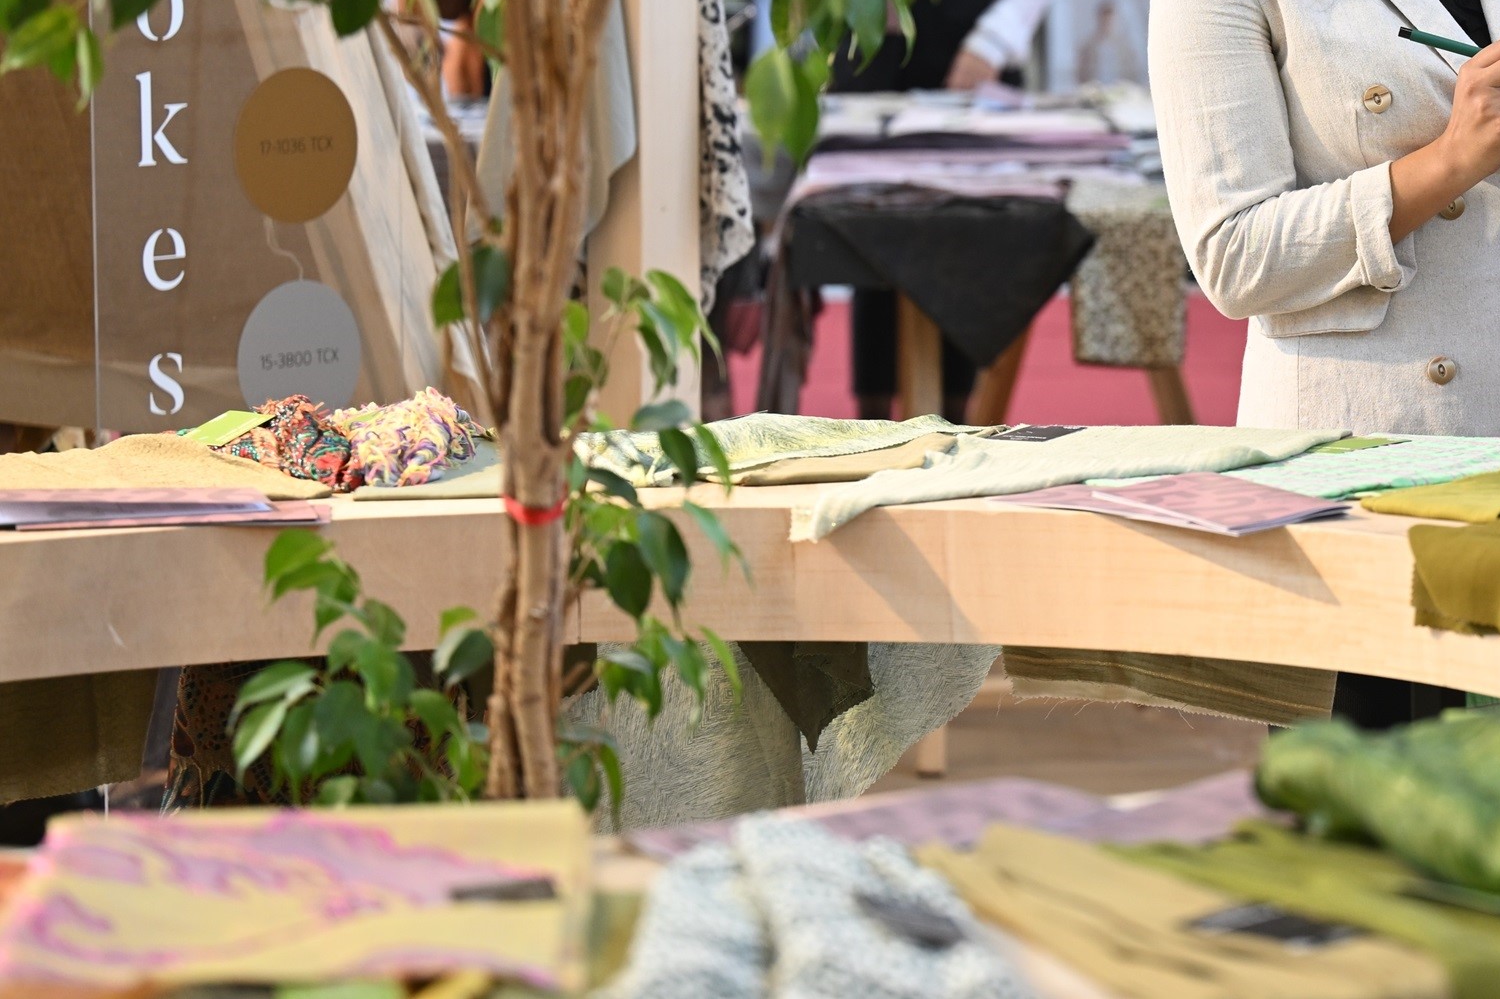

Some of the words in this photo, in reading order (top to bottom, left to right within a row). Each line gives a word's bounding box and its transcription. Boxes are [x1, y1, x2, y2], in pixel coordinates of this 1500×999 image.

[259, 137, 306, 156] 17-1036
[311, 135, 333, 153] TCX
[259, 349, 313, 372] 15-3800
[317, 346, 340, 365] TCX
